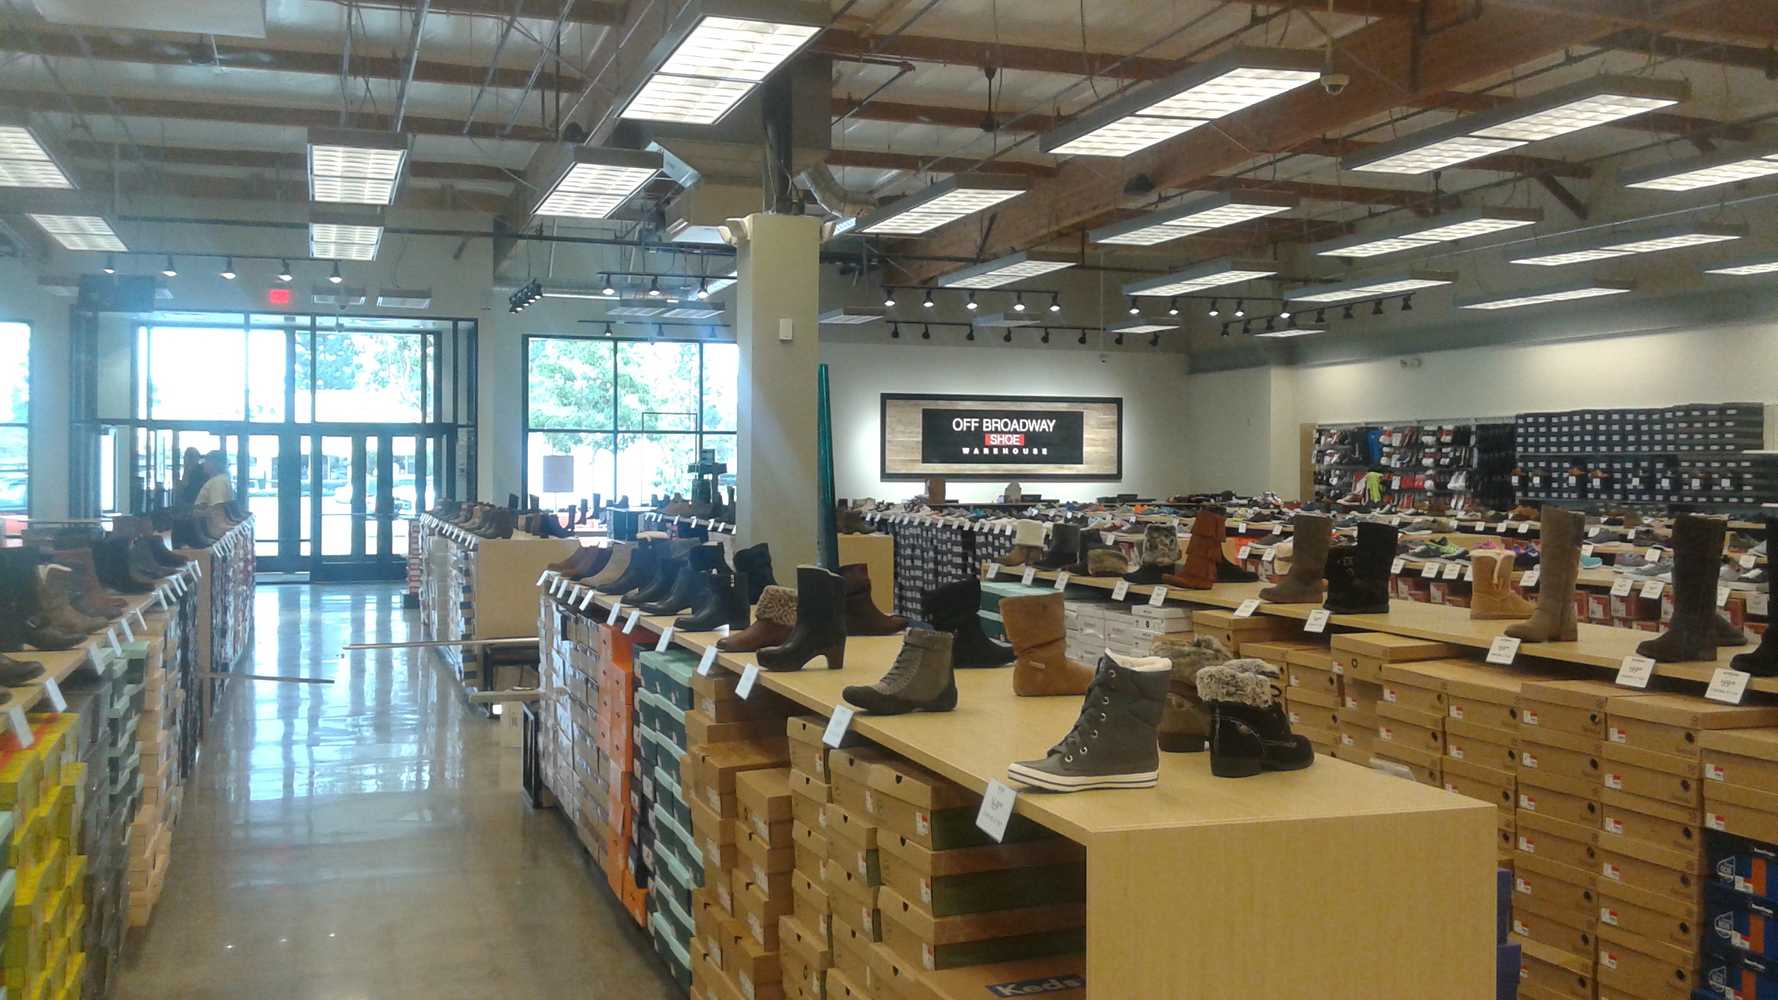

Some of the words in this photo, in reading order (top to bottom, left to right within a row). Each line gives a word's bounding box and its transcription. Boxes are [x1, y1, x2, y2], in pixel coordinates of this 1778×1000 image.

[952, 418, 979, 431] OFF
[983, 418, 1056, 432] BROADWAY
[990, 434, 1020, 446] SHOE
[962, 447, 1048, 455] WAREHOUSE
